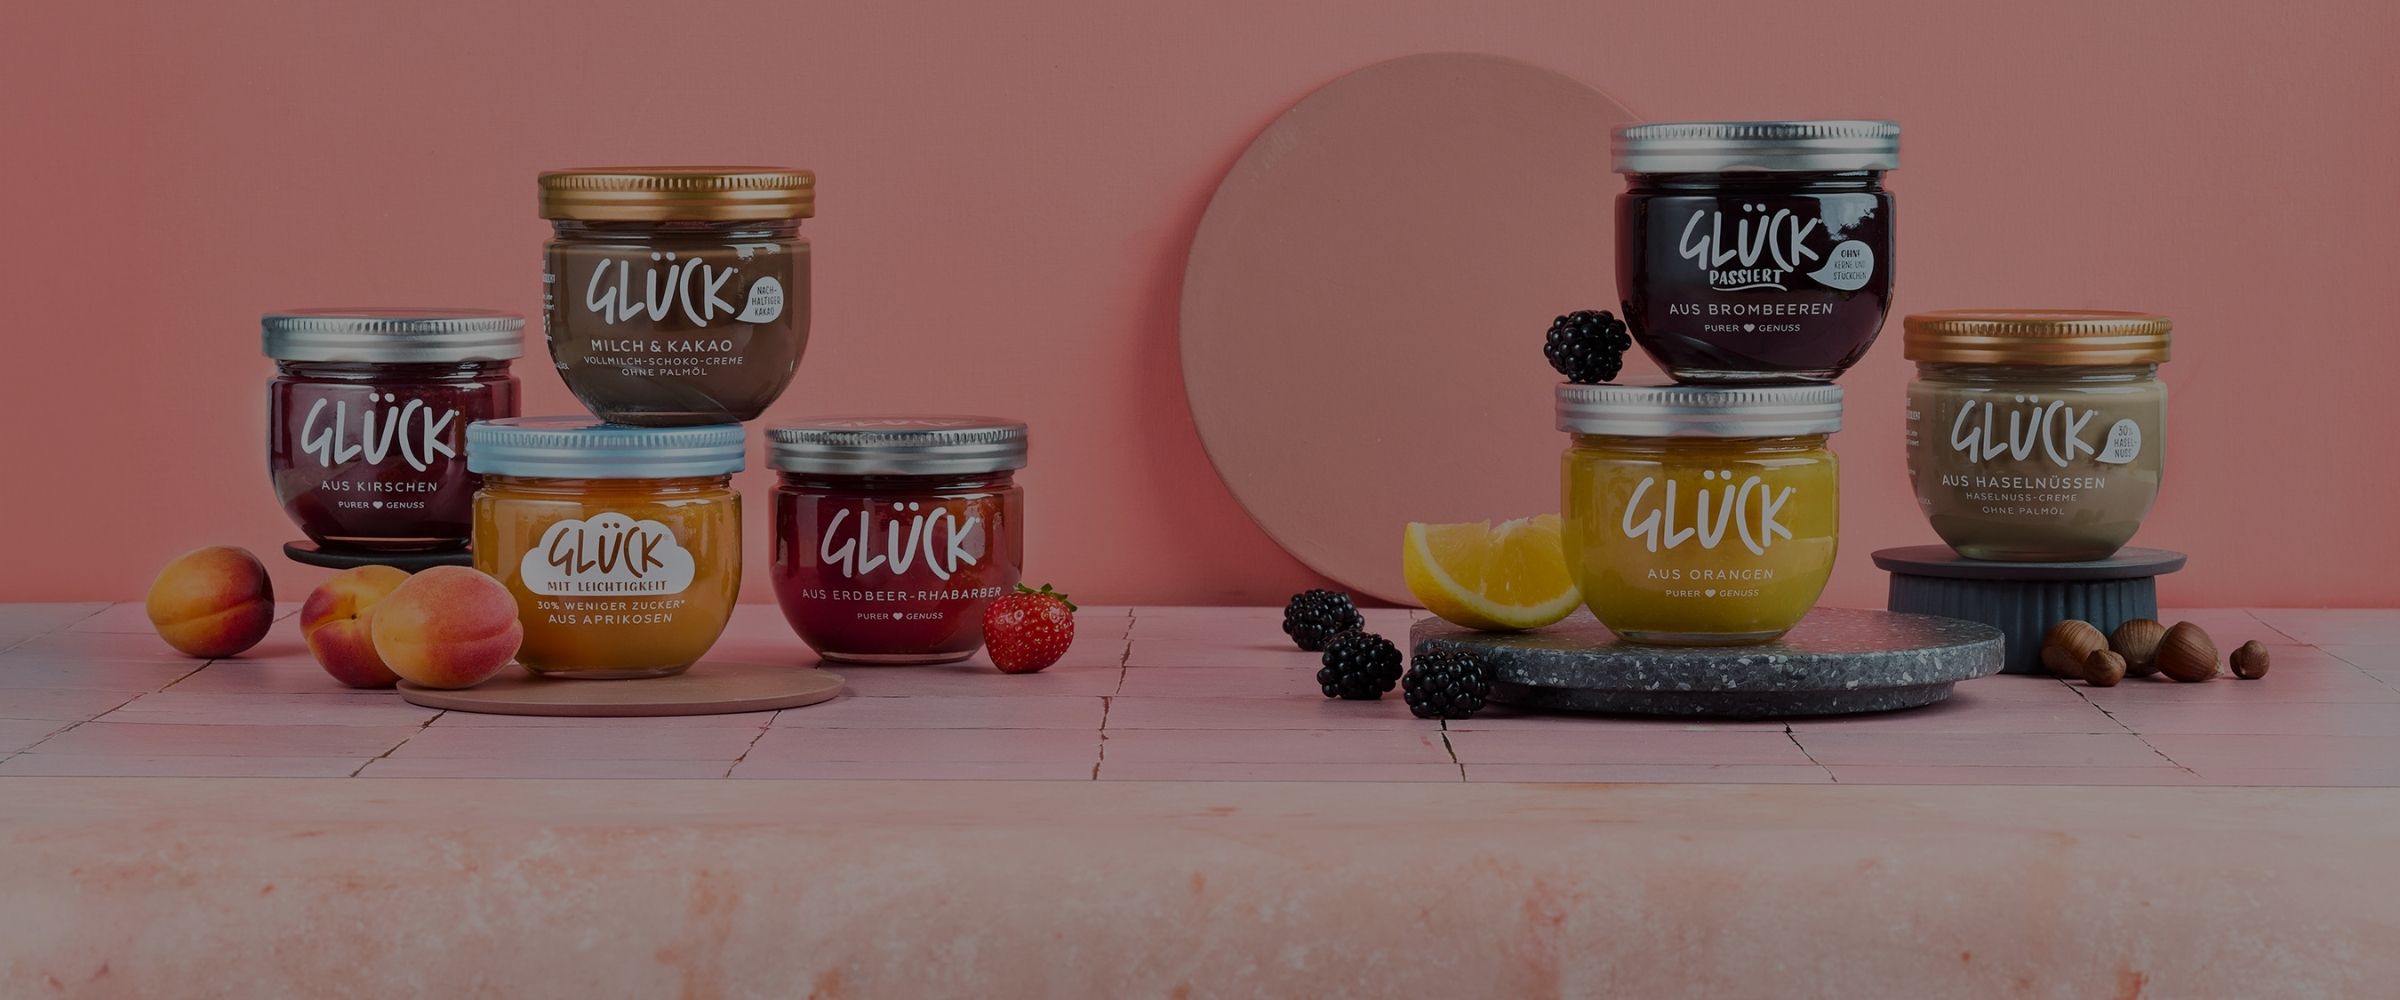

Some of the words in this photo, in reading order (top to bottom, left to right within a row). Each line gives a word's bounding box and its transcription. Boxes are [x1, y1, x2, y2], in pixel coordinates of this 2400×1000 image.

[1679, 203, 1822, 273] GLÜCK
[1710, 269, 1784, 285] PASSIERT
[586, 252, 738, 328] GLÜCK
[755, 307, 774, 315] KAKAO
[1670, 304, 1700, 315] AUS
[1709, 303, 1833, 315] BROMBEEREN
[1705, 324, 1739, 332] PURER
[1759, 324, 1800, 332] GENUSS
[592, 340, 643, 352] MILCH
[650, 340, 661, 352] &
[668, 340, 732, 352] KAKAO
[584, 356, 743, 366] VOLLMILCH-SCHOKO-CREME
[622, 368, 654, 376] OHNE
[660, 365, 707, 376] PALMÖL
[301, 393, 459, 472] GLÜCK
[1951, 395, 2098, 468] GLÜCK
[321, 481, 350, 492] AUS
[357, 481, 438, 492] KIRSCHEN
[1942, 475, 1969, 487] AUS
[1977, 474, 2105, 489] HASELNÜSSEN
[1966, 493, 2077, 502] HASELNUSS-CREME
[338, 501, 369, 509] PURER
[386, 501, 425, 509] GENUSS
[1983, 507, 2014, 515] OHNE
[2019, 505, 2064, 515] PALMÖL
[1622, 470, 1797, 556] GLÜCK
[820, 502, 980, 581] GLÜCK
[548, 523, 664, 578] GLÜCK
[1647, 569, 1680, 580] AUS
[1689, 568, 1773, 580] ORANGEN
[547, 581, 571, 592] MIT
[578, 581, 667, 592] LEICHTIGKEIT
[802, 588, 826, 599] AUS
[832, 586, 1002, 601] ERDBEER-RHABARBER
[1719, 589, 1759, 597] GENUSS
[537, 601, 560, 609] 30%
[564, 602, 627, 610] WENIGER
[548, 614, 576, 624] AUS
[582, 613, 673, 624] APRIKOSEN
[857, 612, 889, 620] PURER
[906, 612, 943, 620] GENUSS
